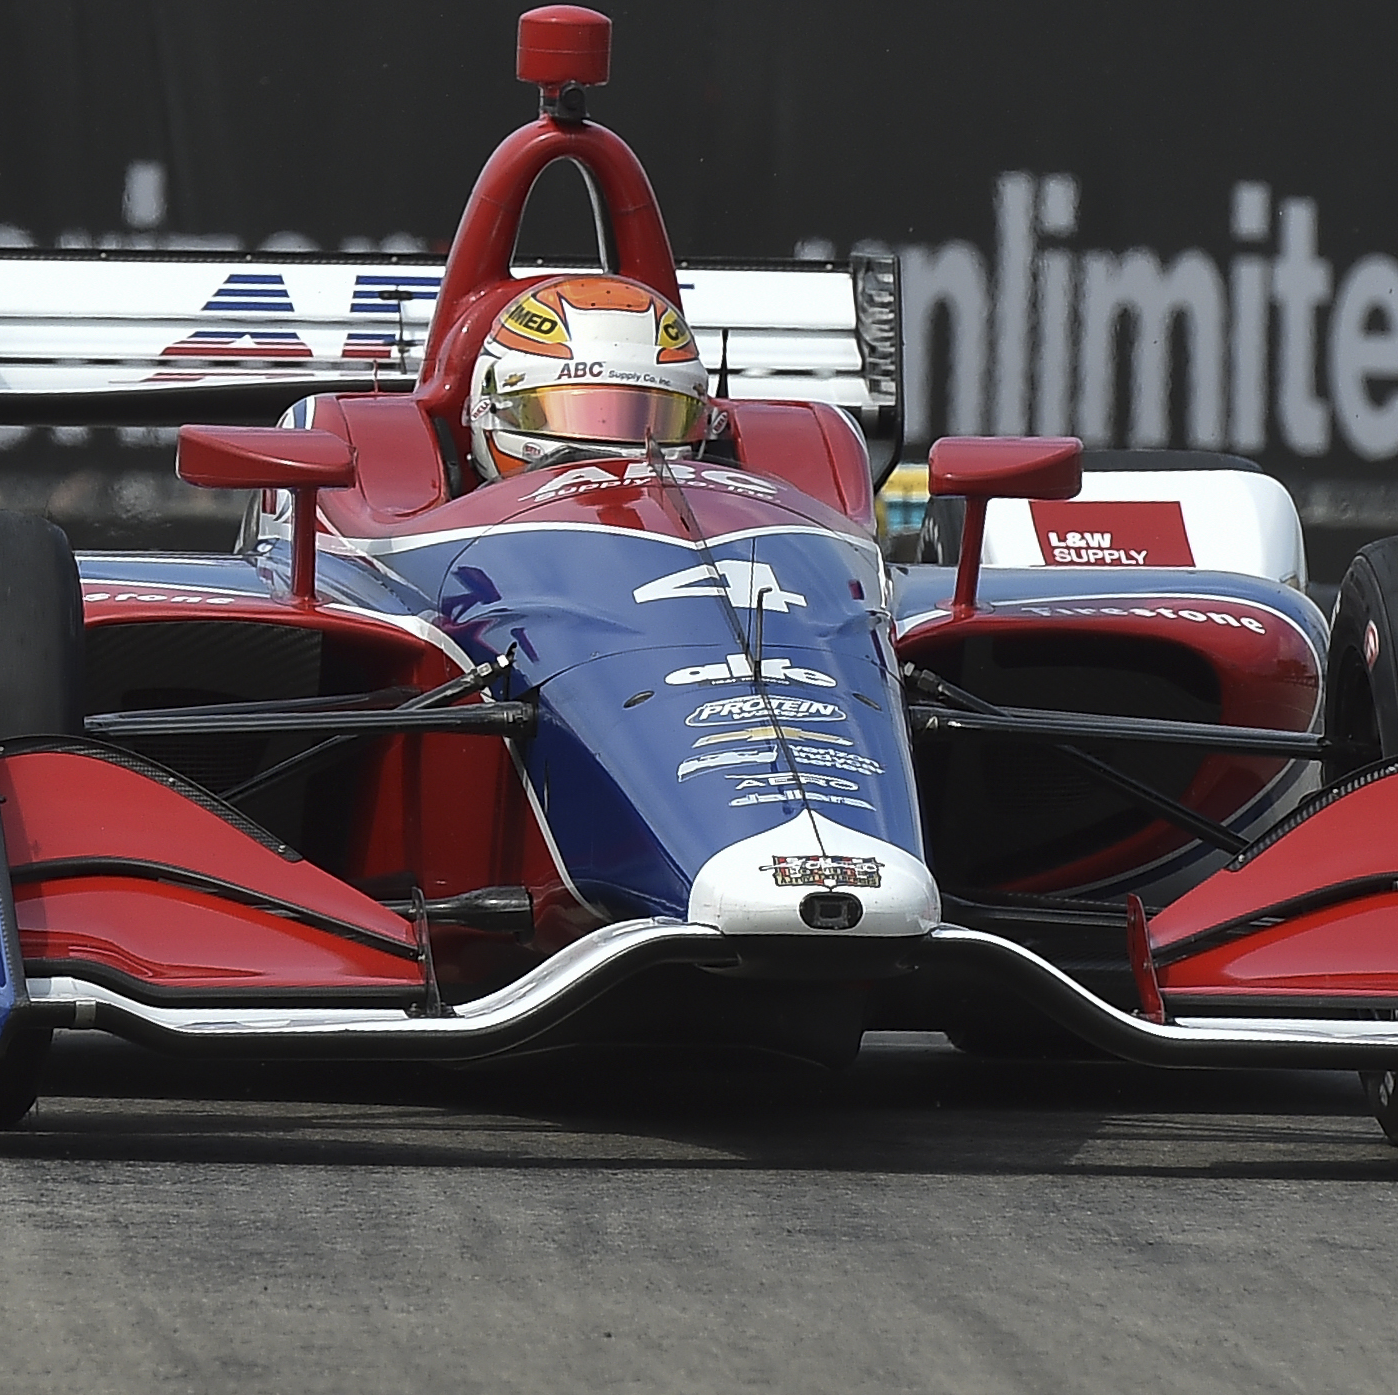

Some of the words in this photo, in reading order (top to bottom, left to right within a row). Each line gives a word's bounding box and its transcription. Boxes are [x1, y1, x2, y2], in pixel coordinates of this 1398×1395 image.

[556, 361, 604, 381] ABC
[607, 369, 641, 382] Supply
[517, 462, 779, 503] ABC
[534, 477, 653, 503] Supply
[1047, 531, 1112, 548] L&W
[1053, 548, 1148, 565] SUPPLY
[633, 559, 808, 614] 4
[1021, 606, 1267, 634] Firestone
[698, 699, 835, 721] PROTEIN
